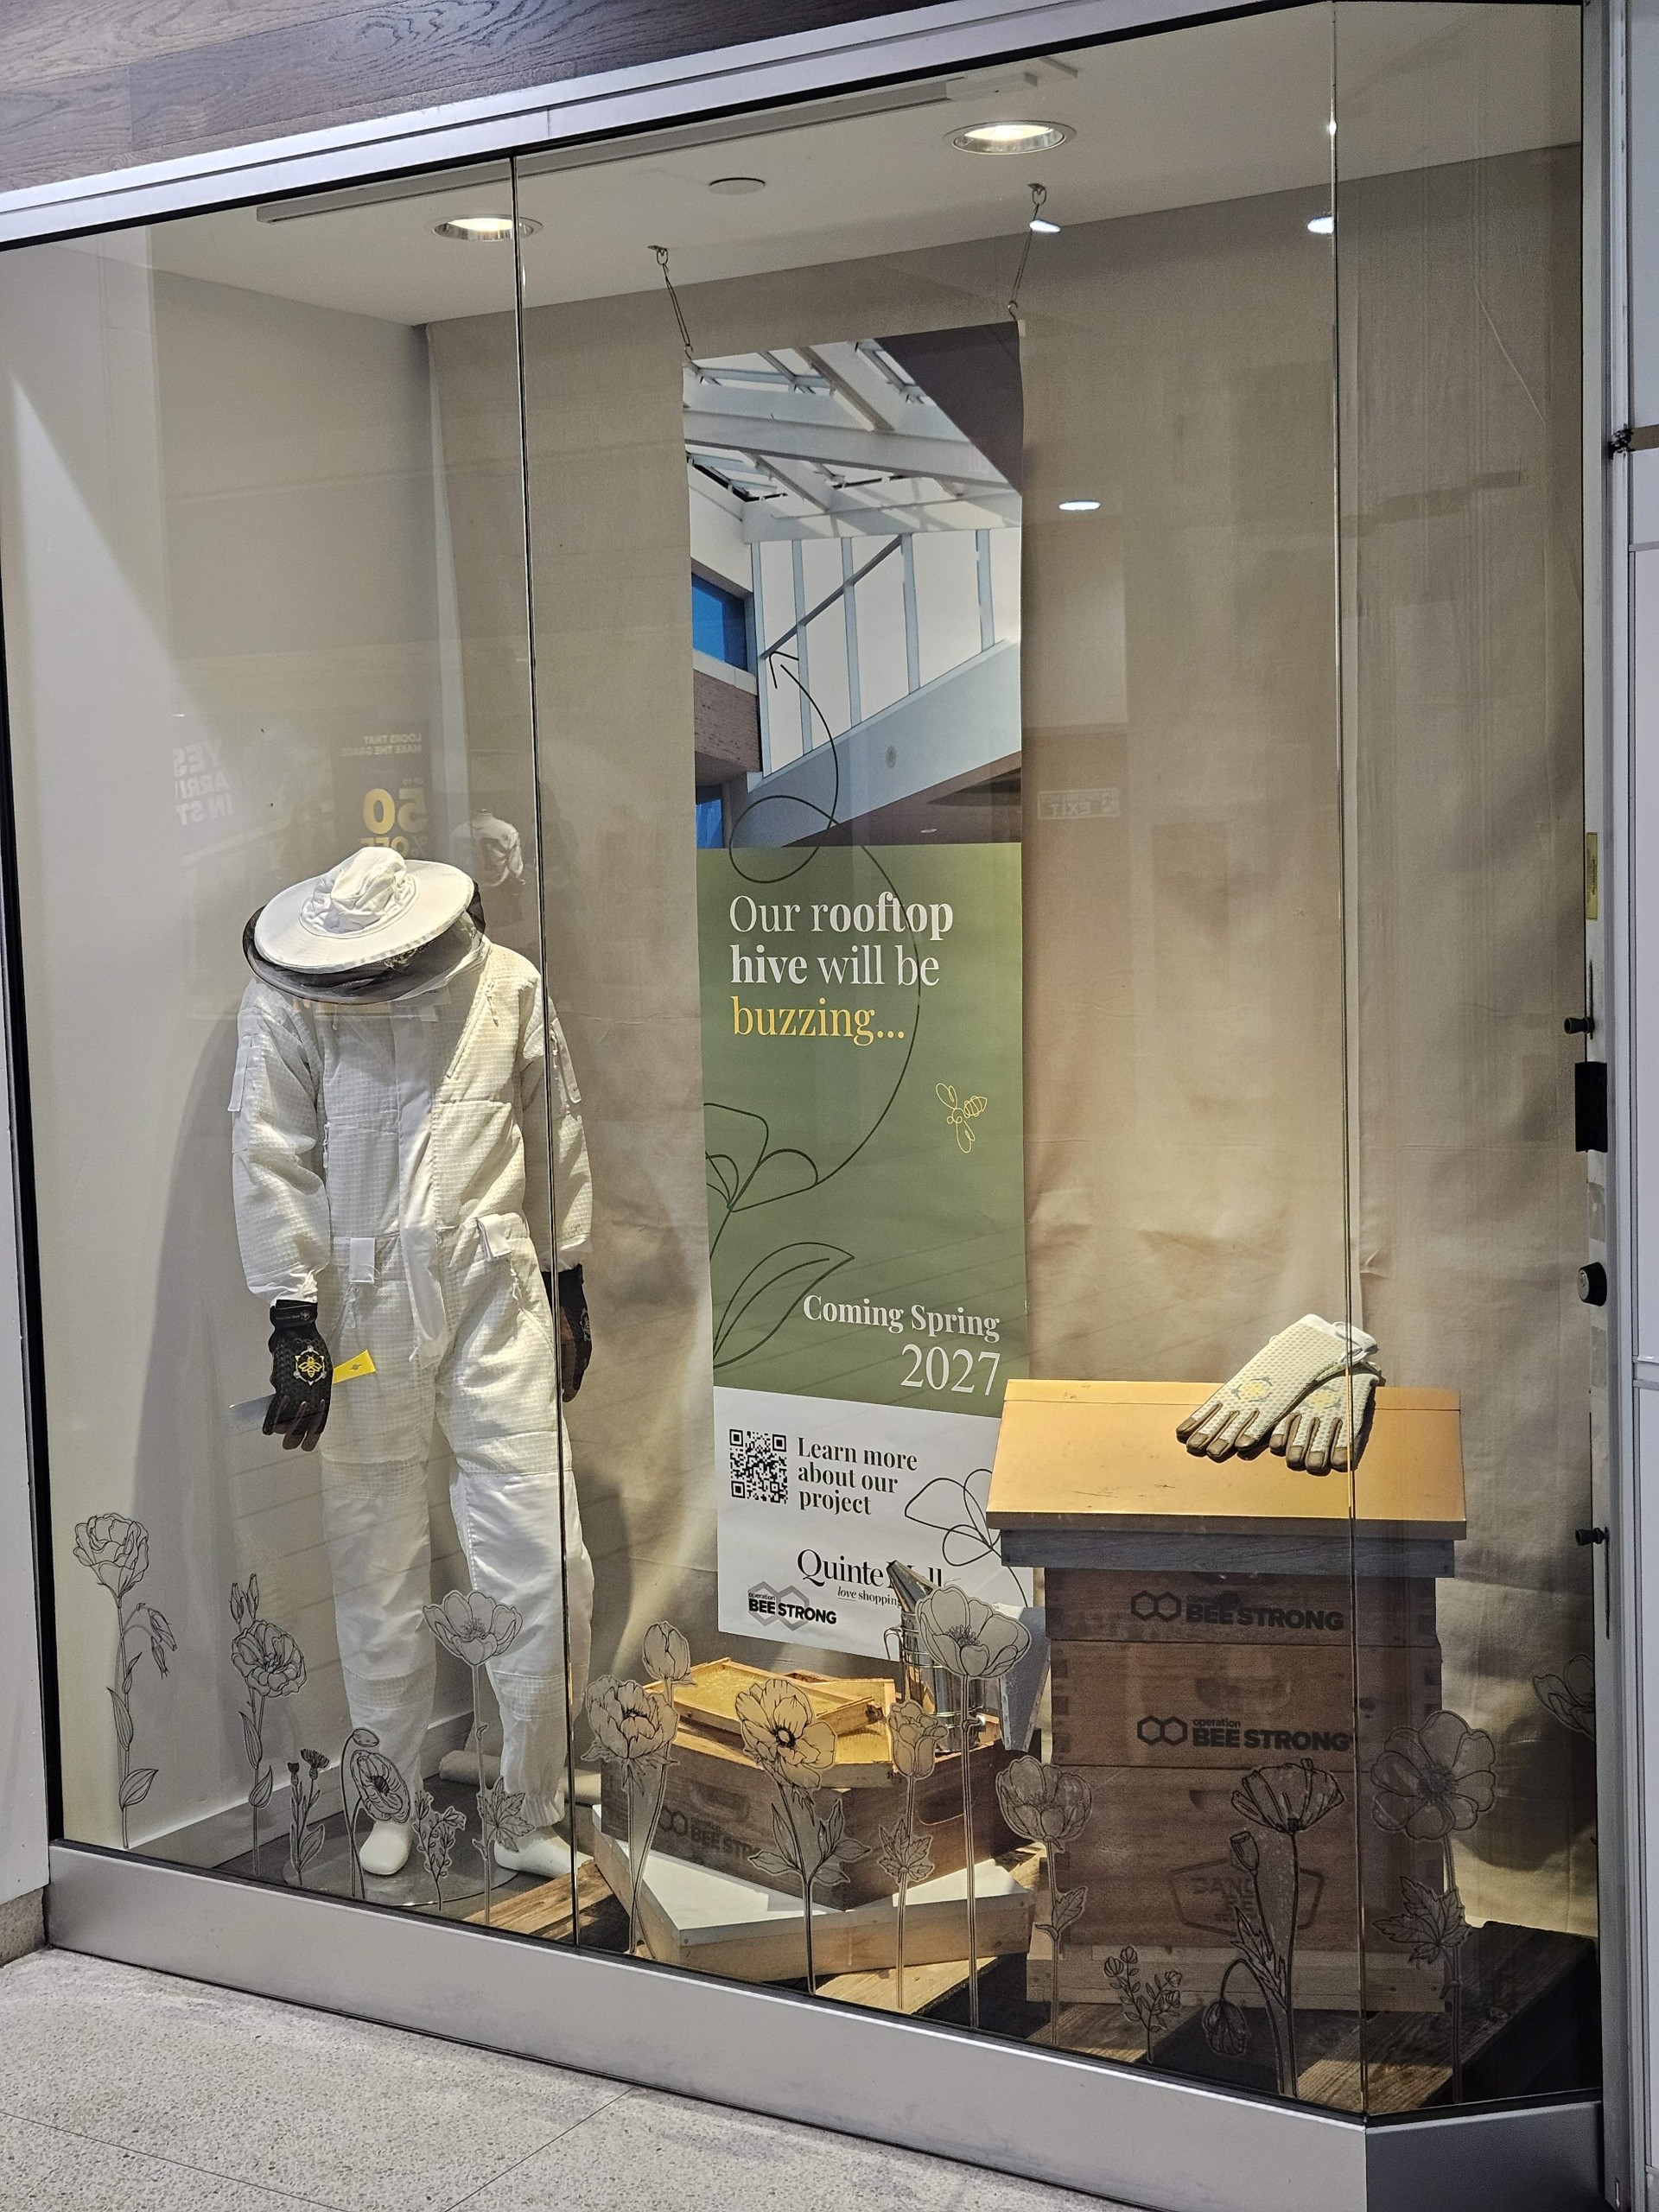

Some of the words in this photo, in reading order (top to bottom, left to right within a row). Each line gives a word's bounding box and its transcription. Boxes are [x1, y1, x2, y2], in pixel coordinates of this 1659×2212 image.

[729, 894, 800, 932] Our
[810, 891, 953, 941] rooftop
[729, 944, 807, 984] hive
[817, 944, 885, 985] will
[894, 944, 940, 987] be
[730, 996, 905, 1046] buzzing...
[803, 1294, 905, 1334] Coming
[910, 1304, 1001, 1344] Spring
[900, 1344, 1001, 1396] 2027
[798, 1437, 857, 1463] Learn
[864, 1449, 918, 1471] more
[798, 1462, 857, 1489] about
[861, 1474, 899, 1494] our
[798, 1489, 872, 1516] project
[797, 1548, 884, 1588] Quinte
[748, 1592, 776, 1601] operation
[836, 1586, 857, 1599] love
[748, 1599, 776, 1615] BEE
[778, 1602, 837, 1624] STRONG
[1186, 1603, 1234, 1624] BEE
[1237, 1606, 1344, 1630] STRONG
[1192, 1718, 1242, 1728] operation
[1192, 1727, 1241, 1748] BEE
[1243, 1729, 1351, 1752] STRONG
[691, 1827, 721, 1852] BEE
